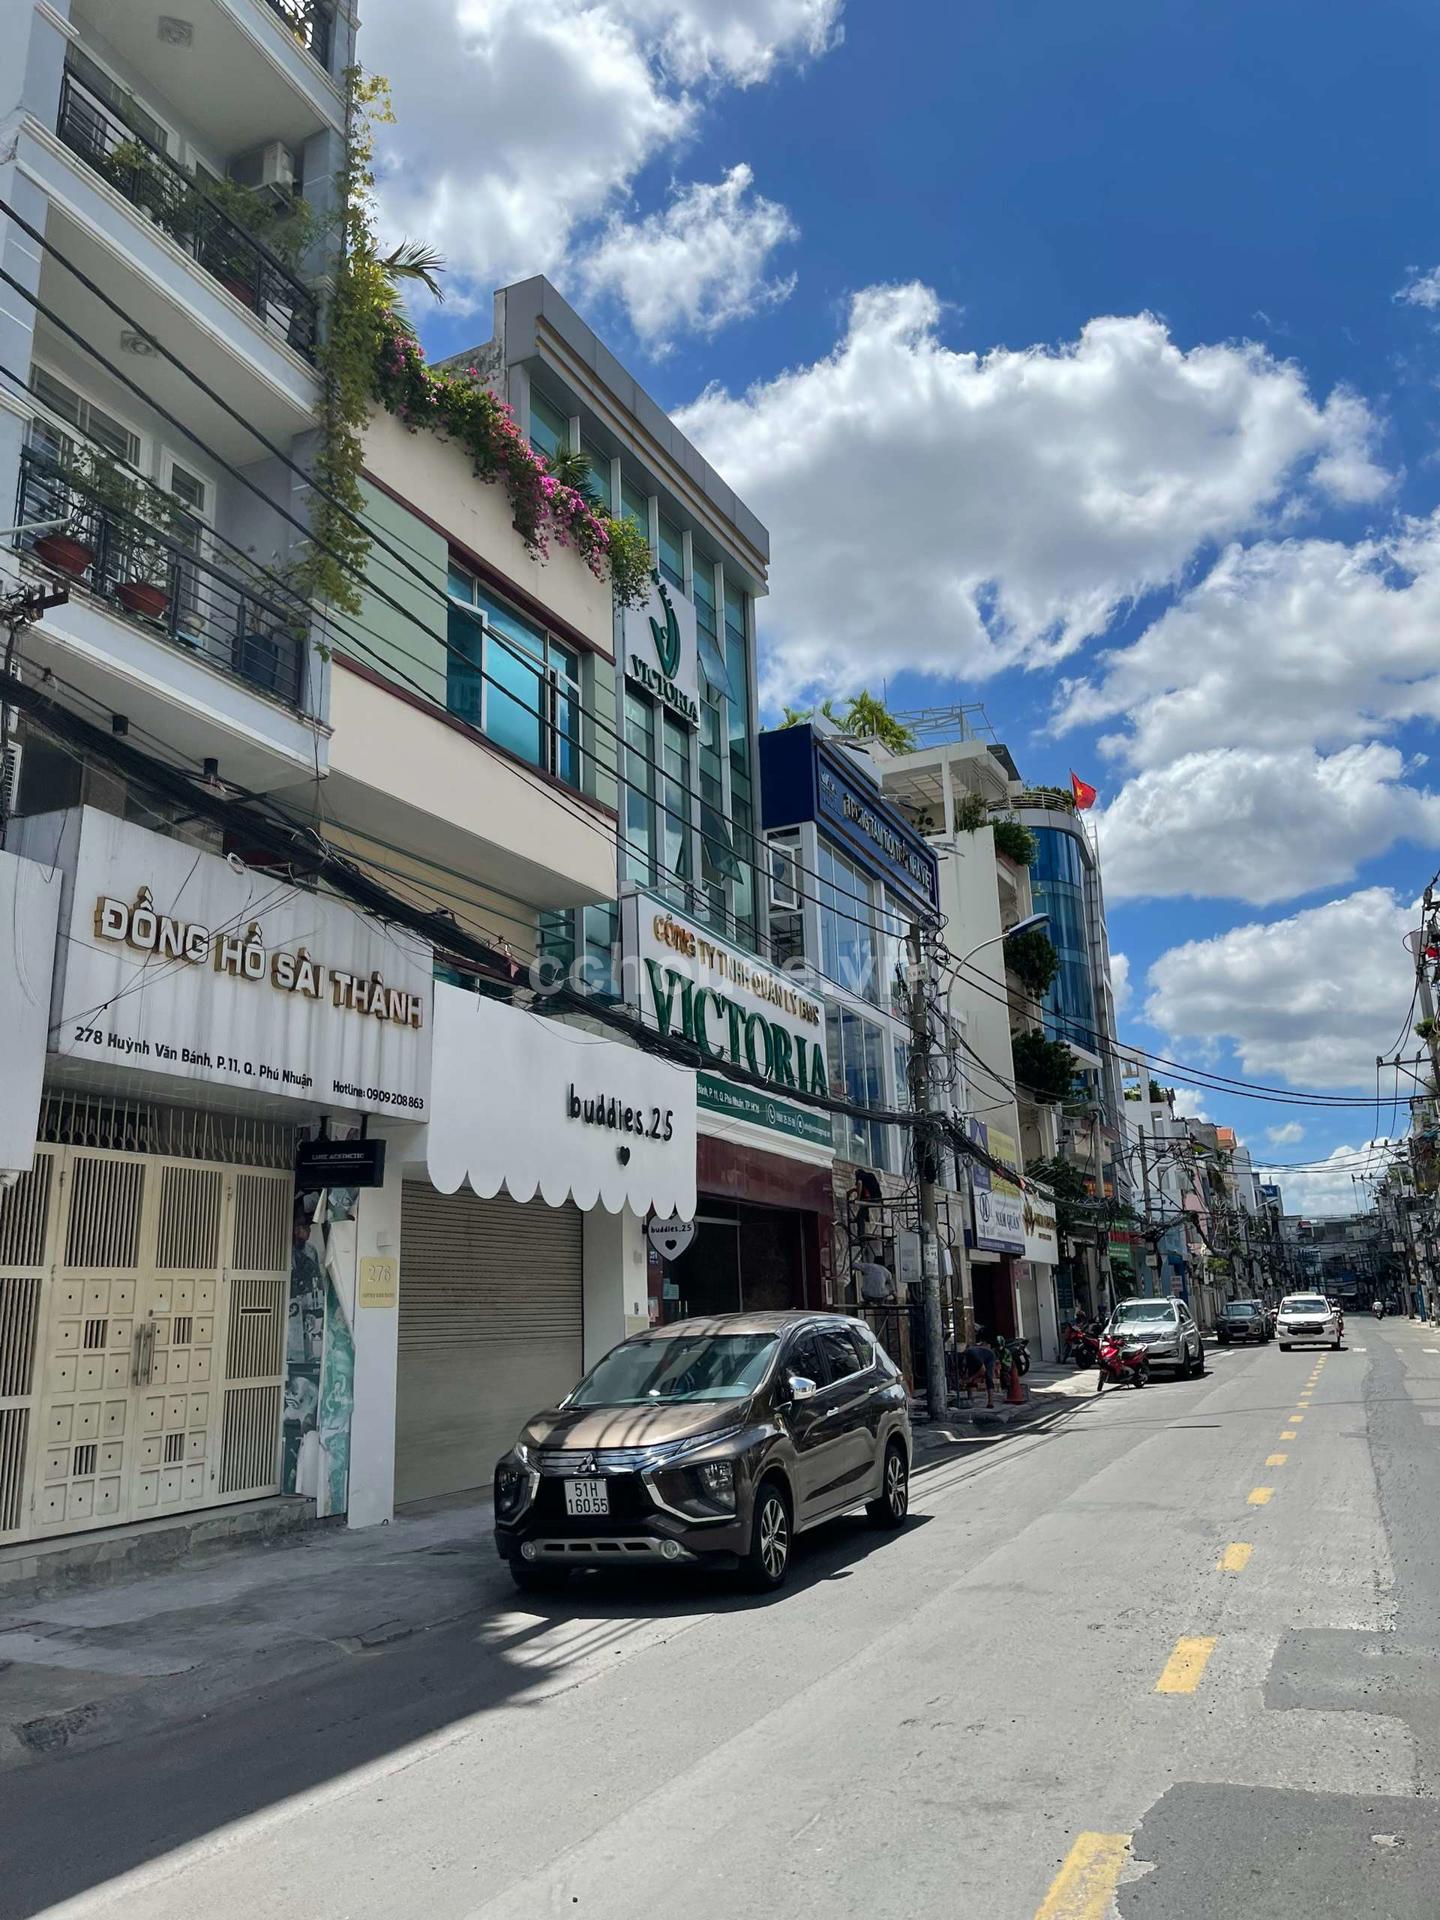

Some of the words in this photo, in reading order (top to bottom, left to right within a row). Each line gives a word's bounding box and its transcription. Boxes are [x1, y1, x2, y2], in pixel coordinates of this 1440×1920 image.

[631, 654, 699, 723] VICTORIA
[94, 885, 210, 965] ĐỒNG
[213, 921, 267, 982] HỒ
[270, 946, 326, 1000] SÀI
[329, 969, 424, 1030] THÀNH
[653, 913, 697, 959] CÔNG
[697, 938, 716, 970] TY
[74, 1026, 103, 1045] 278
[107, 1032, 149, 1055] Huỳnh
[155, 1042, 178, 1061] Văn
[181, 1048, 213, 1069] Bánh,
[243, 1061, 257, 1076] Q.
[259, 1064, 280, 1081] Phú
[282, 1069, 313, 1089] Nhuận
[643, 957, 830, 1099] VICTORIA
[566, 1082, 675, 1142] buddies.25
[650, 1223, 692, 1233] buddies.25
[568, 1498, 608, 1514] 160.55
[574, 1482, 598, 1498] 51H
